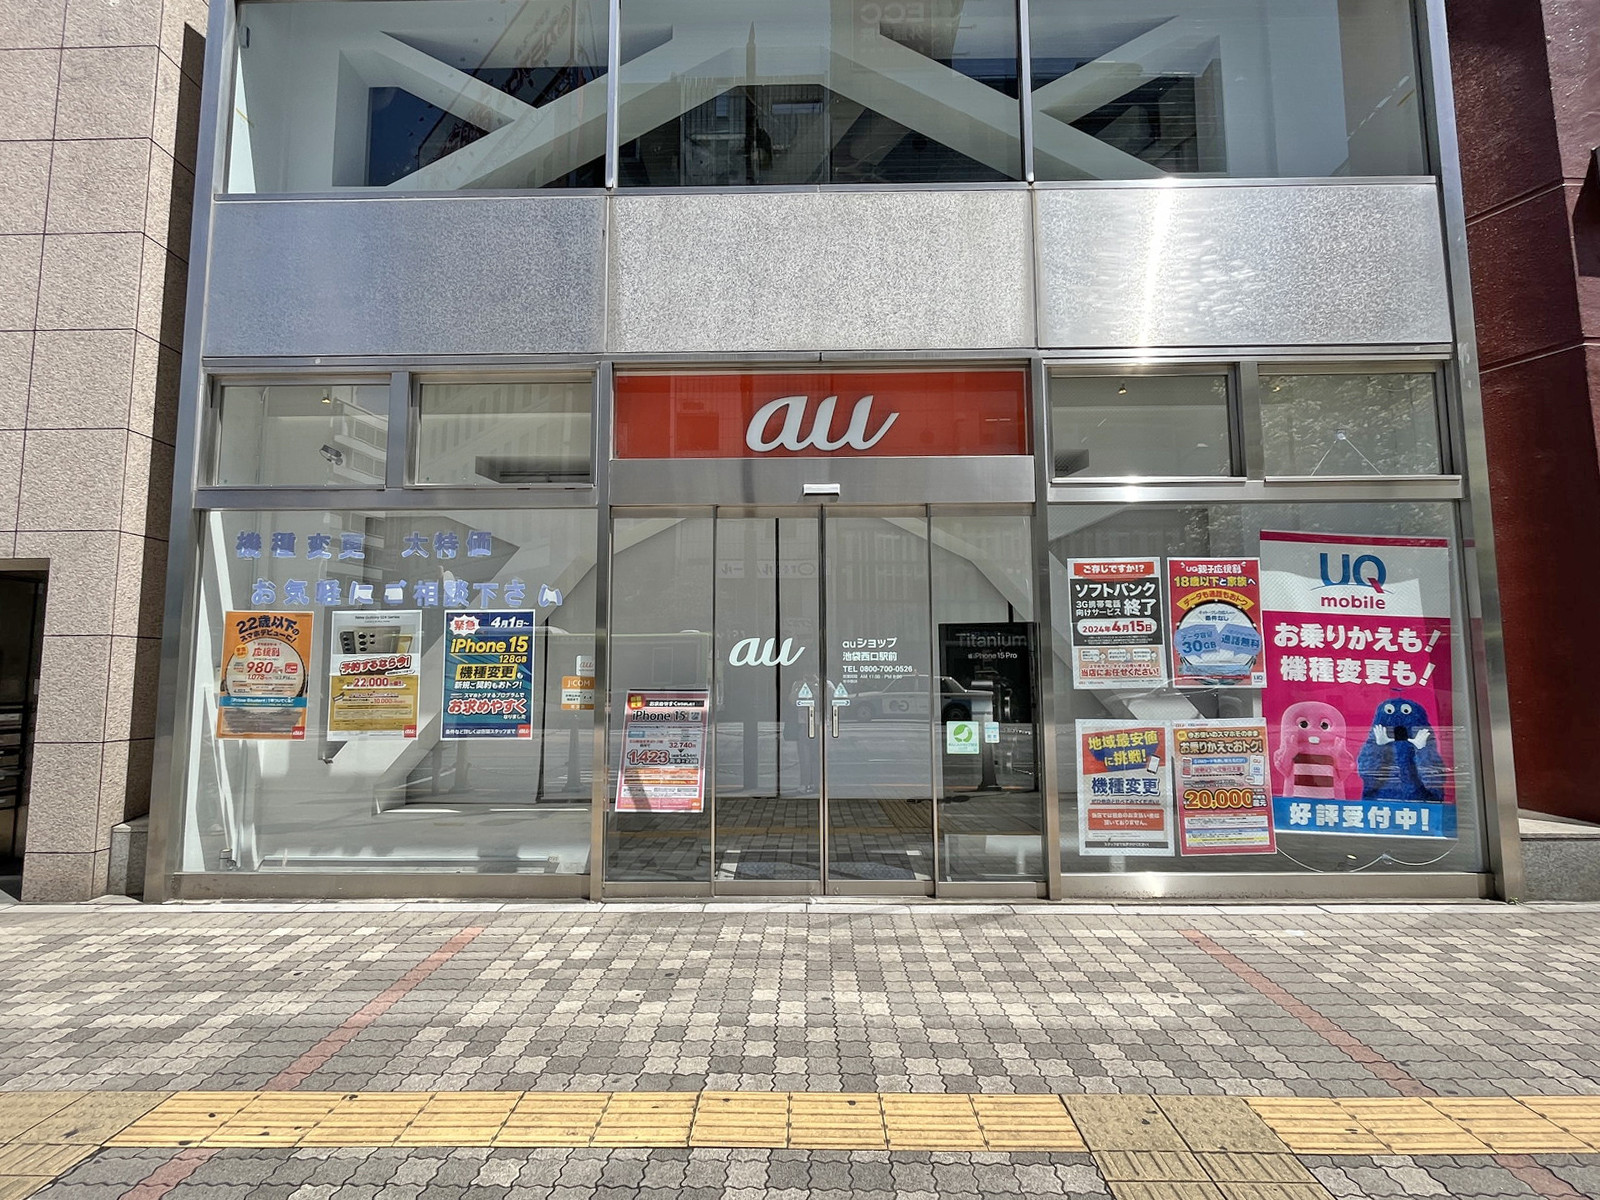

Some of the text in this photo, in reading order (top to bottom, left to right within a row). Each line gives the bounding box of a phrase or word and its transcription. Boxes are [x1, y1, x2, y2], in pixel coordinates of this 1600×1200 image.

[745, 394, 899, 452] au
[236, 531, 492, 560] 機種変更 大特価
[1083, 564, 1145, 574] ご存じですか!?
[1319, 553, 1387, 594] UQ
[1174, 576, 1256, 587] 18歳以下と家族へ
[251, 578, 563, 608] お気軽にご相談下さい
[1075, 582, 1156, 598] ソフトバンク
[1184, 590, 1248, 606] データも通話もおトク
[1076, 598, 1157, 616] 3G携帯電話 終了
[1321, 595, 1386, 609] mobile
[1076, 608, 1122, 617] 向けサービス
[236, 615, 300, 635] 22歳以下の
[454, 620, 476, 631] 緊急
[1082, 620, 1153, 633] 2024年4月15日
[450, 636, 529, 653] iPhone 15
[842, 637, 898, 648] auショップ
[955, 632, 1028, 647] Titanium
[1274, 622, 1441, 653] お乗りかえも!
[728, 637, 806, 667] au
[1182, 640, 1217, 653] 30GB
[340, 655, 411, 673] 予約するなら今!
[499, 655, 527, 663] 128GB
[842, 651, 898, 661] 池袋西口駅前
[247, 661, 273, 674] 980
[842, 665, 858, 673] TEL
[1081, 667, 1160, 677] 当店にお任せください!
[1280, 655, 1436, 686] 機種変更も!
[448, 698, 528, 715] お求めやすく
[632, 710, 671, 721] iPhone
[674, 710, 687, 720] 15
[1088, 730, 1158, 750] 地域最安値
[1180, 740, 1263, 754] お乗りかえでおトク!
[1104, 749, 1147, 766] に挑戦!
[1091, 777, 1160, 795] 機種変更
[1184, 789, 1253, 809] 20,000
[1289, 802, 1430, 832] 好評受付中!
